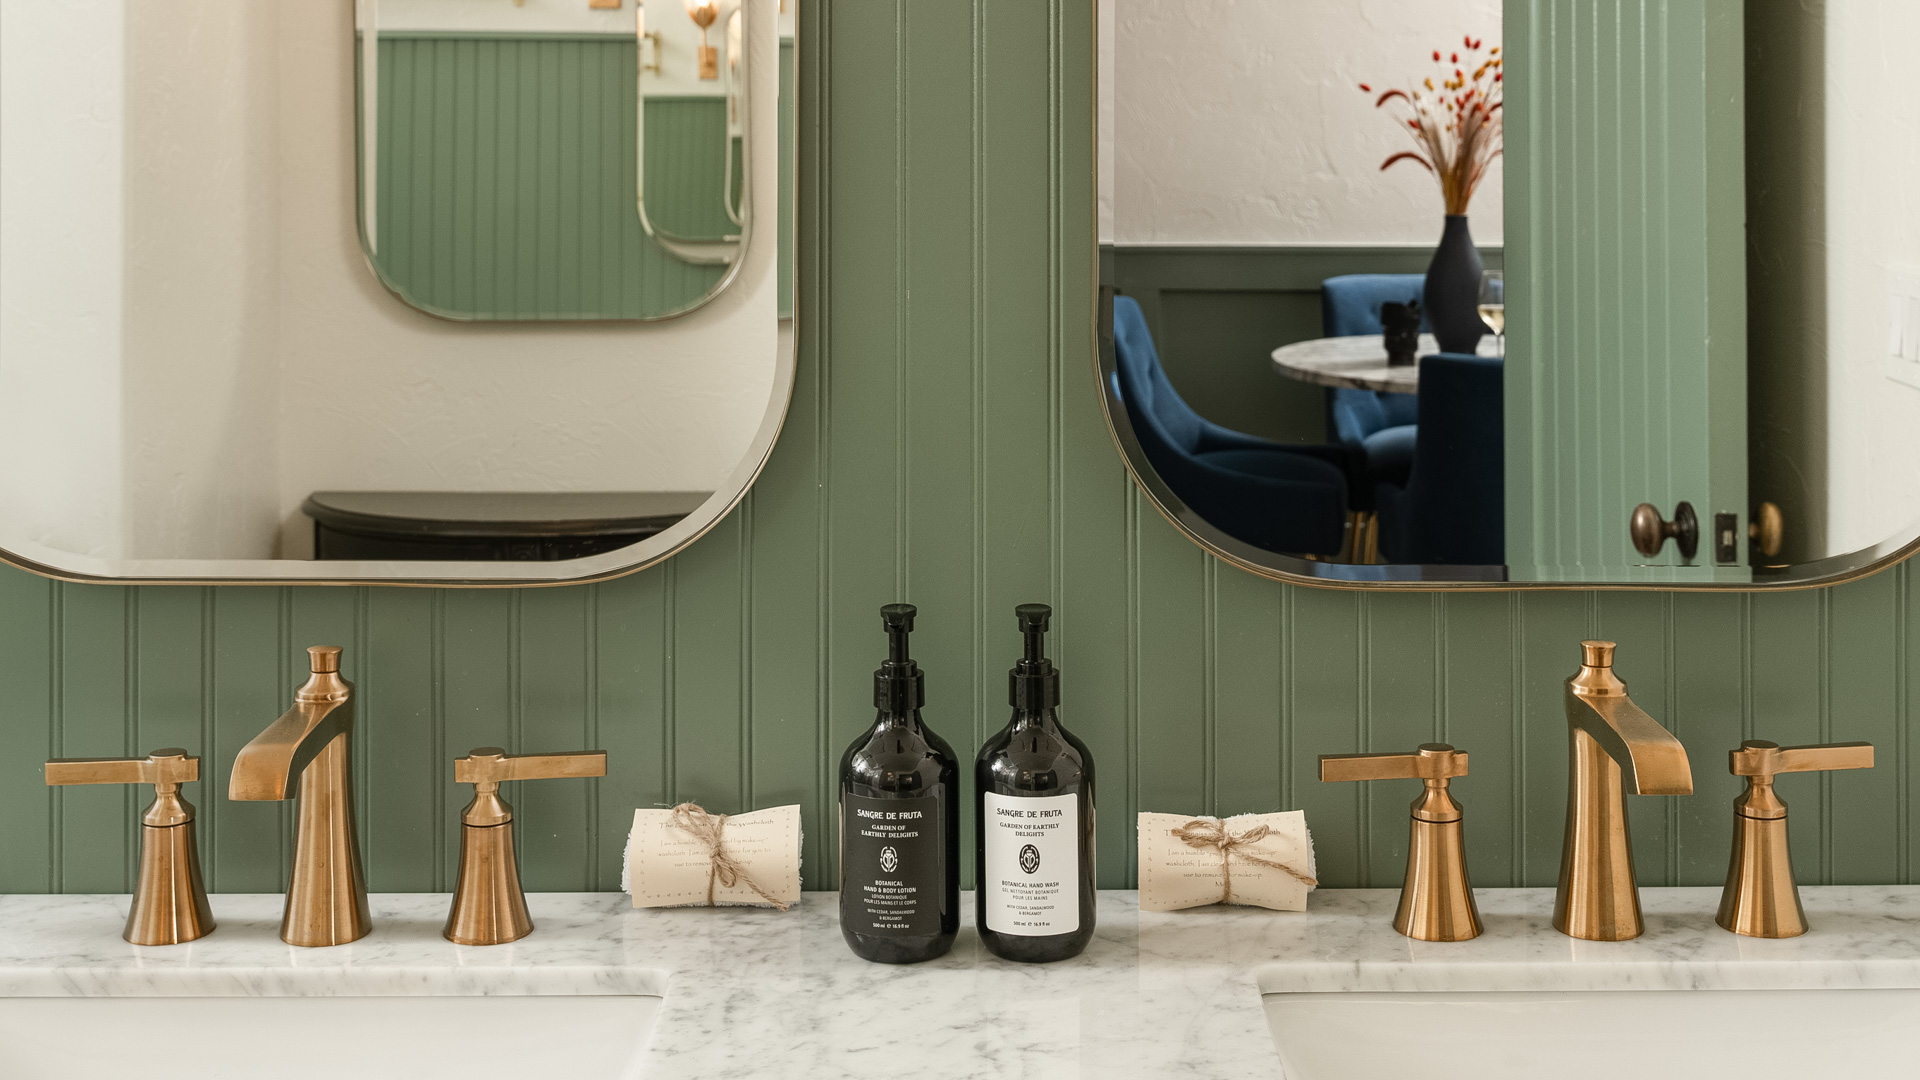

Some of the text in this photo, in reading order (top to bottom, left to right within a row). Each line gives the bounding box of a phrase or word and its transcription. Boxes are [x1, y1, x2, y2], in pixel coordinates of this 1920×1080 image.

[857, 809, 883, 819] SANGRE
[899, 811, 922, 819] FRUTA
[997, 808, 1024, 818] SANGRE
[861, 830, 886, 838] EARTHLY
